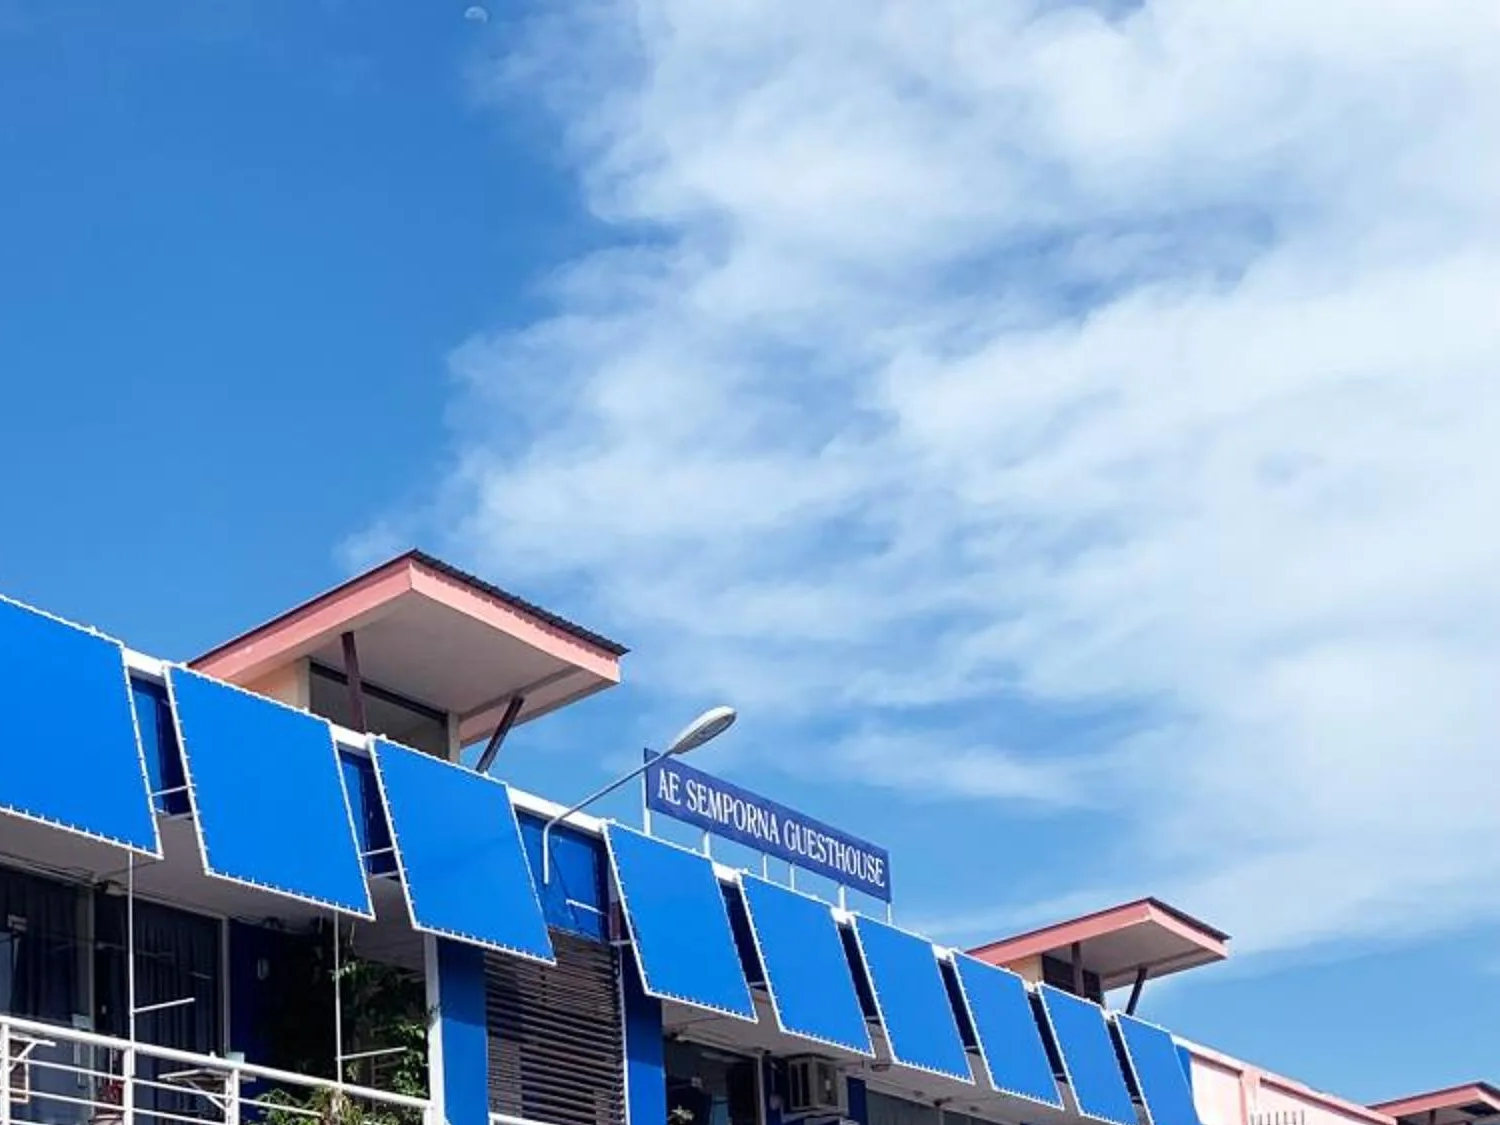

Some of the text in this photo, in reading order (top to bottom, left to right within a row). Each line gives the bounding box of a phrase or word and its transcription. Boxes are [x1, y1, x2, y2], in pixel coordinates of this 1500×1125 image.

[658, 768, 885, 887] AE SEMPORNA GUESTHOUSE
